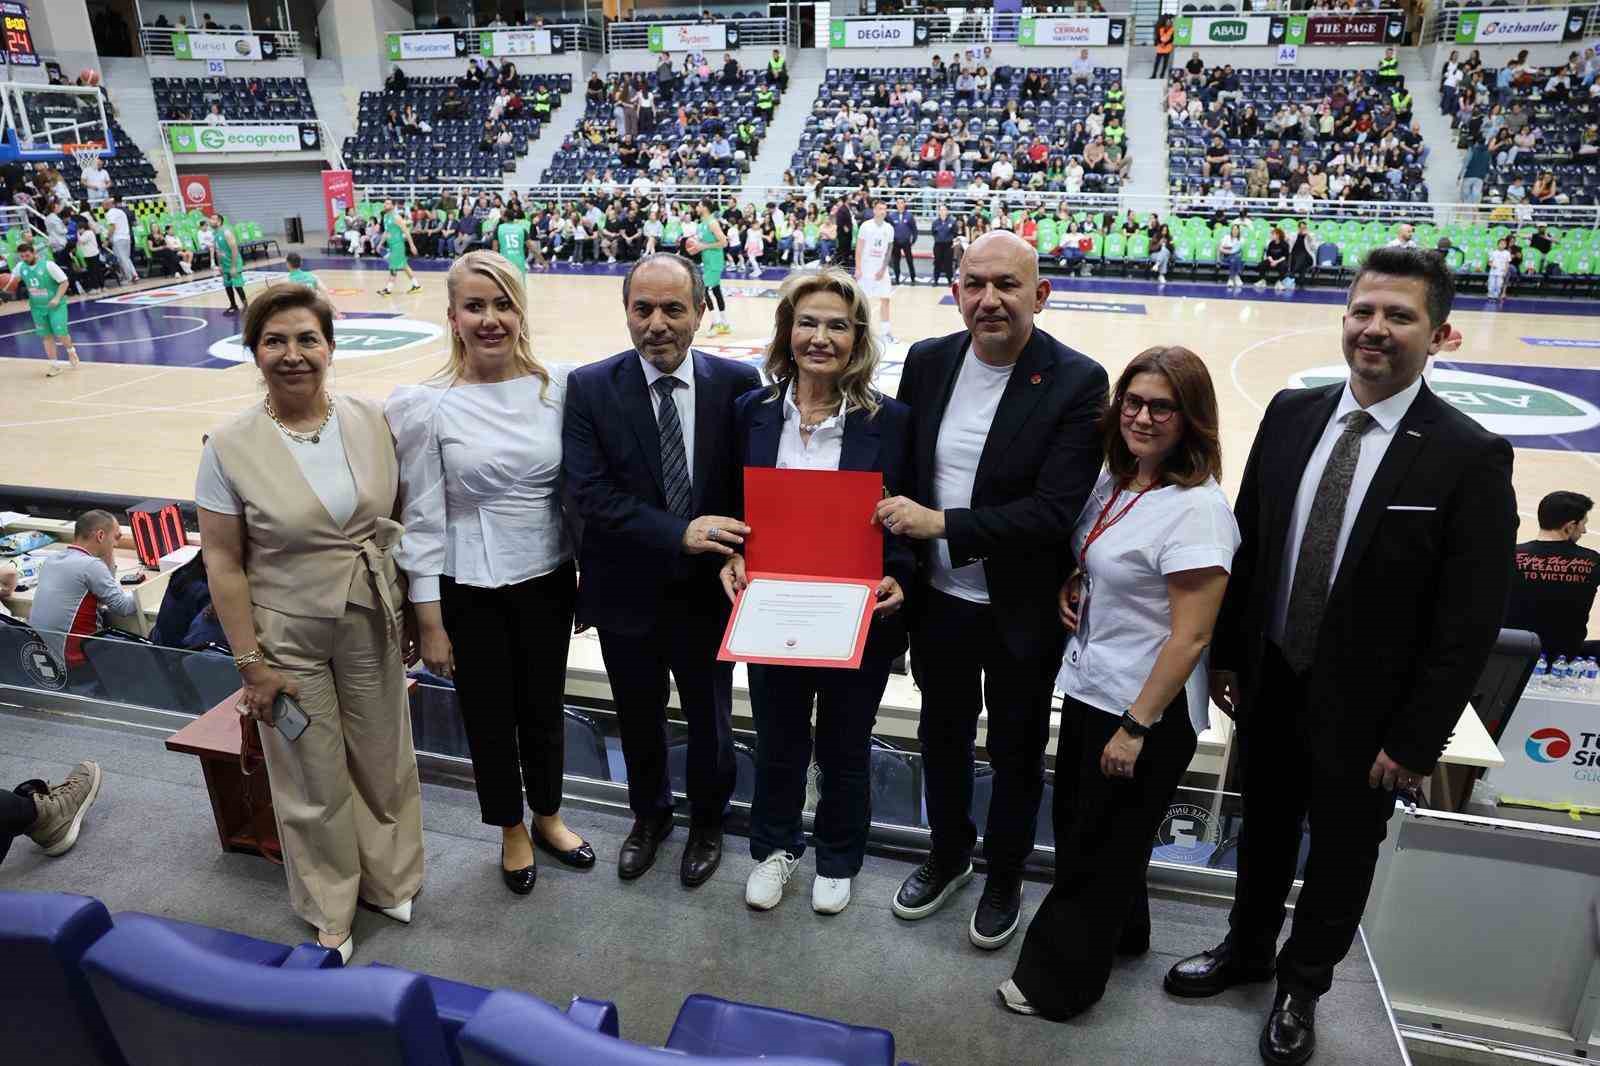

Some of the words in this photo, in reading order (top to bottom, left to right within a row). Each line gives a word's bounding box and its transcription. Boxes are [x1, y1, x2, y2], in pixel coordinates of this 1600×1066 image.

[1314, 23, 1340, 33] THE
[1344, 22, 1377, 33] PAGE
[7, 31, 30, 53] 24
[1279, 49, 1296, 59] A4
[228, 132, 295, 147] ecogreen
[505, 234, 520, 249] 15
[1571, 565, 1592, 575] YOU
[1523, 571, 1538, 581] TO
